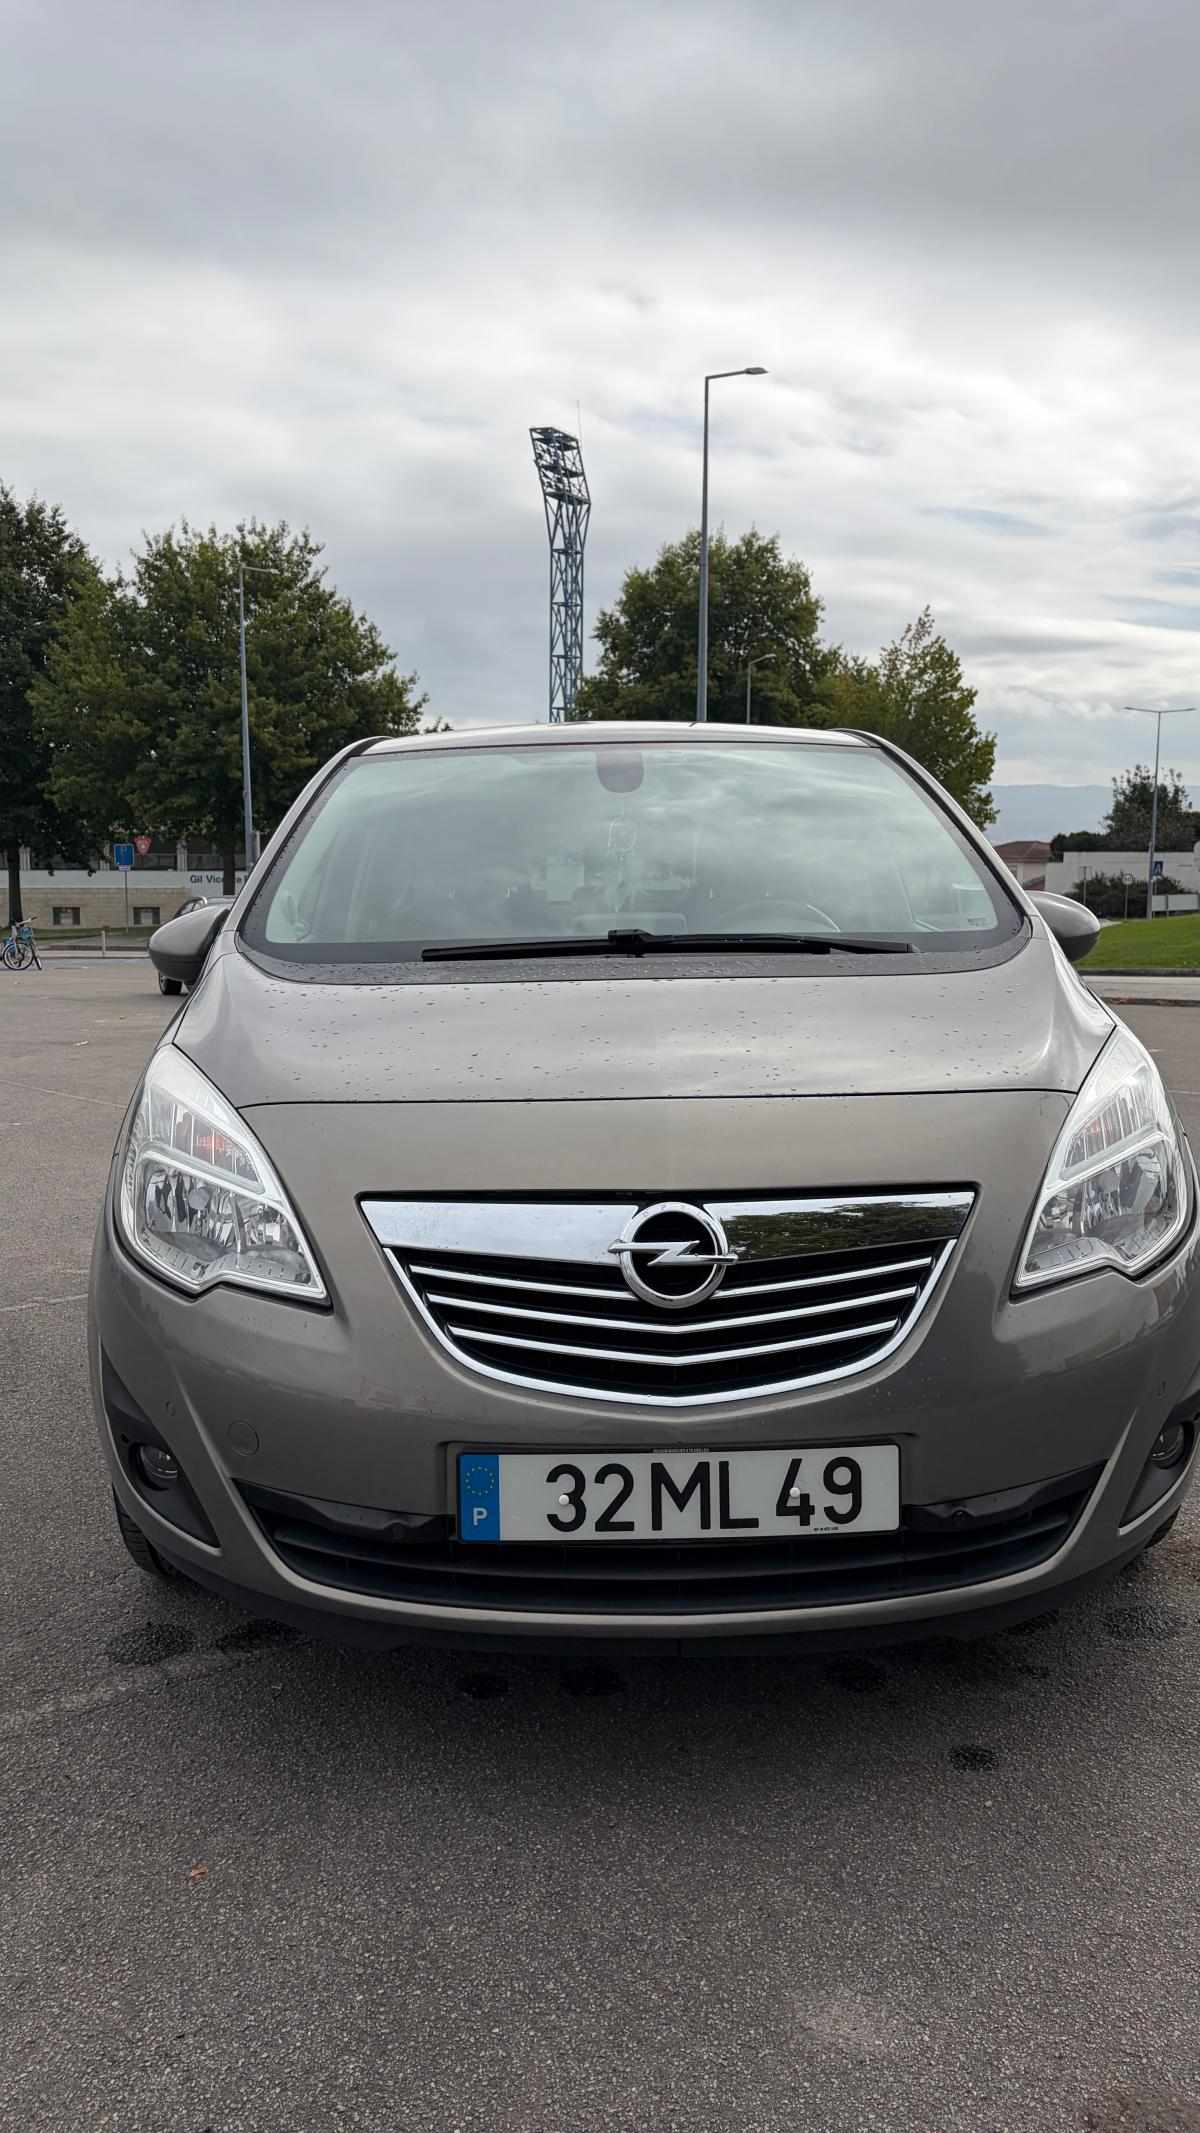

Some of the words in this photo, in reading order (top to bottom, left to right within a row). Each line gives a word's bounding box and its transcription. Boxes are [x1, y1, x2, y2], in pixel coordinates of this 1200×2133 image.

[190, 874, 203, 883] Gil
[545, 1463, 635, 1533] 32
[650, 1460, 760, 1531] ML
[775, 1456, 863, 1527] 49
[473, 1507, 488, 1526] P
